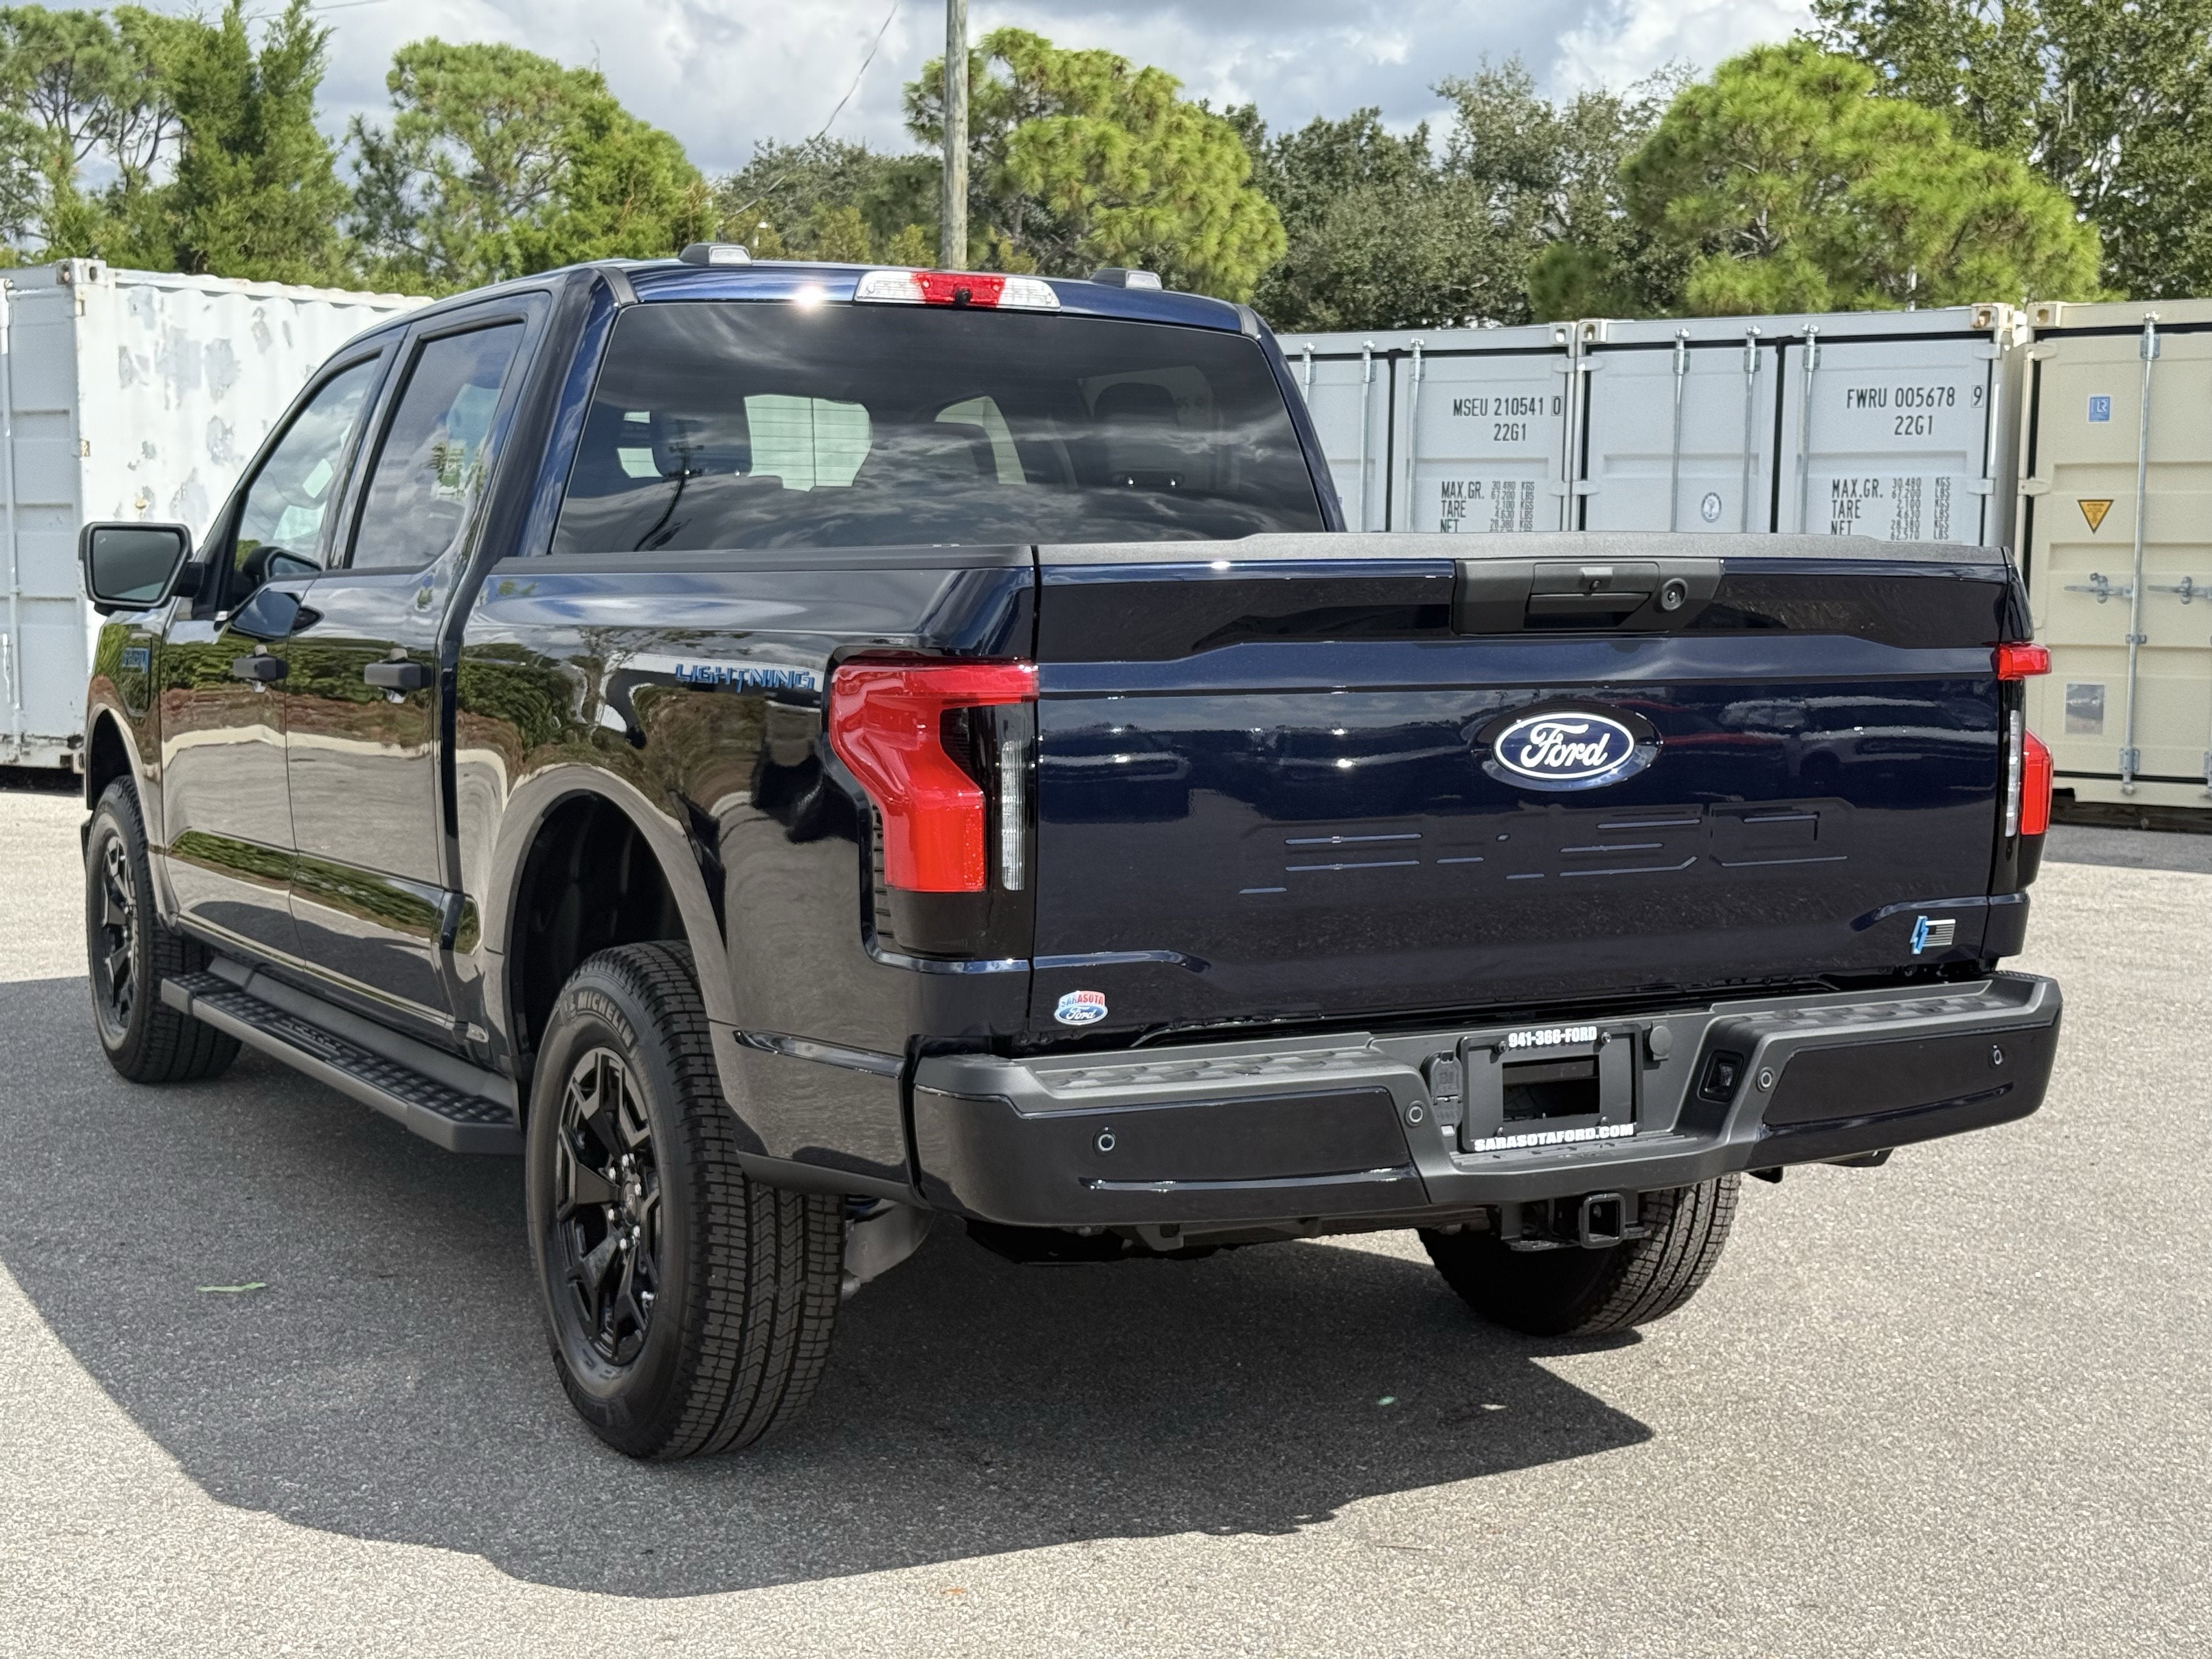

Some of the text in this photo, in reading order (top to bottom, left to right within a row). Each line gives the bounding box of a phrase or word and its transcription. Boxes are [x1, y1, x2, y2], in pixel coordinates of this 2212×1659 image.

[1453, 397, 1561, 416] MSEU 210541 0
[1847, 386, 1983, 409] FWRU 005678 9
[1493, 423, 1526, 441] 22G1
[1894, 415, 1933, 436] 22G1
[1441, 481, 1485, 499] MAX.GR.
[1832, 478, 1883, 499] MAX.GR.
[1936, 477, 1951, 489] KGS
[1441, 500, 1466, 518] TARE
[1521, 501, 1534, 510] KGS
[1831, 499, 1861, 519] TARE
[1935, 499, 1950, 510] KGS
[1933, 530, 1949, 540] LBS
[675, 663, 815, 694] LIGHTNING
[1520, 723, 1611, 768] Ford
[577, 990, 635, 1048] MICHELIN
[1066, 1006, 1097, 1020] Ford
[1508, 1026, 1598, 1048] 941-366-FORD
[1474, 1122, 1634, 1152] SARASOTAFORD.COM
